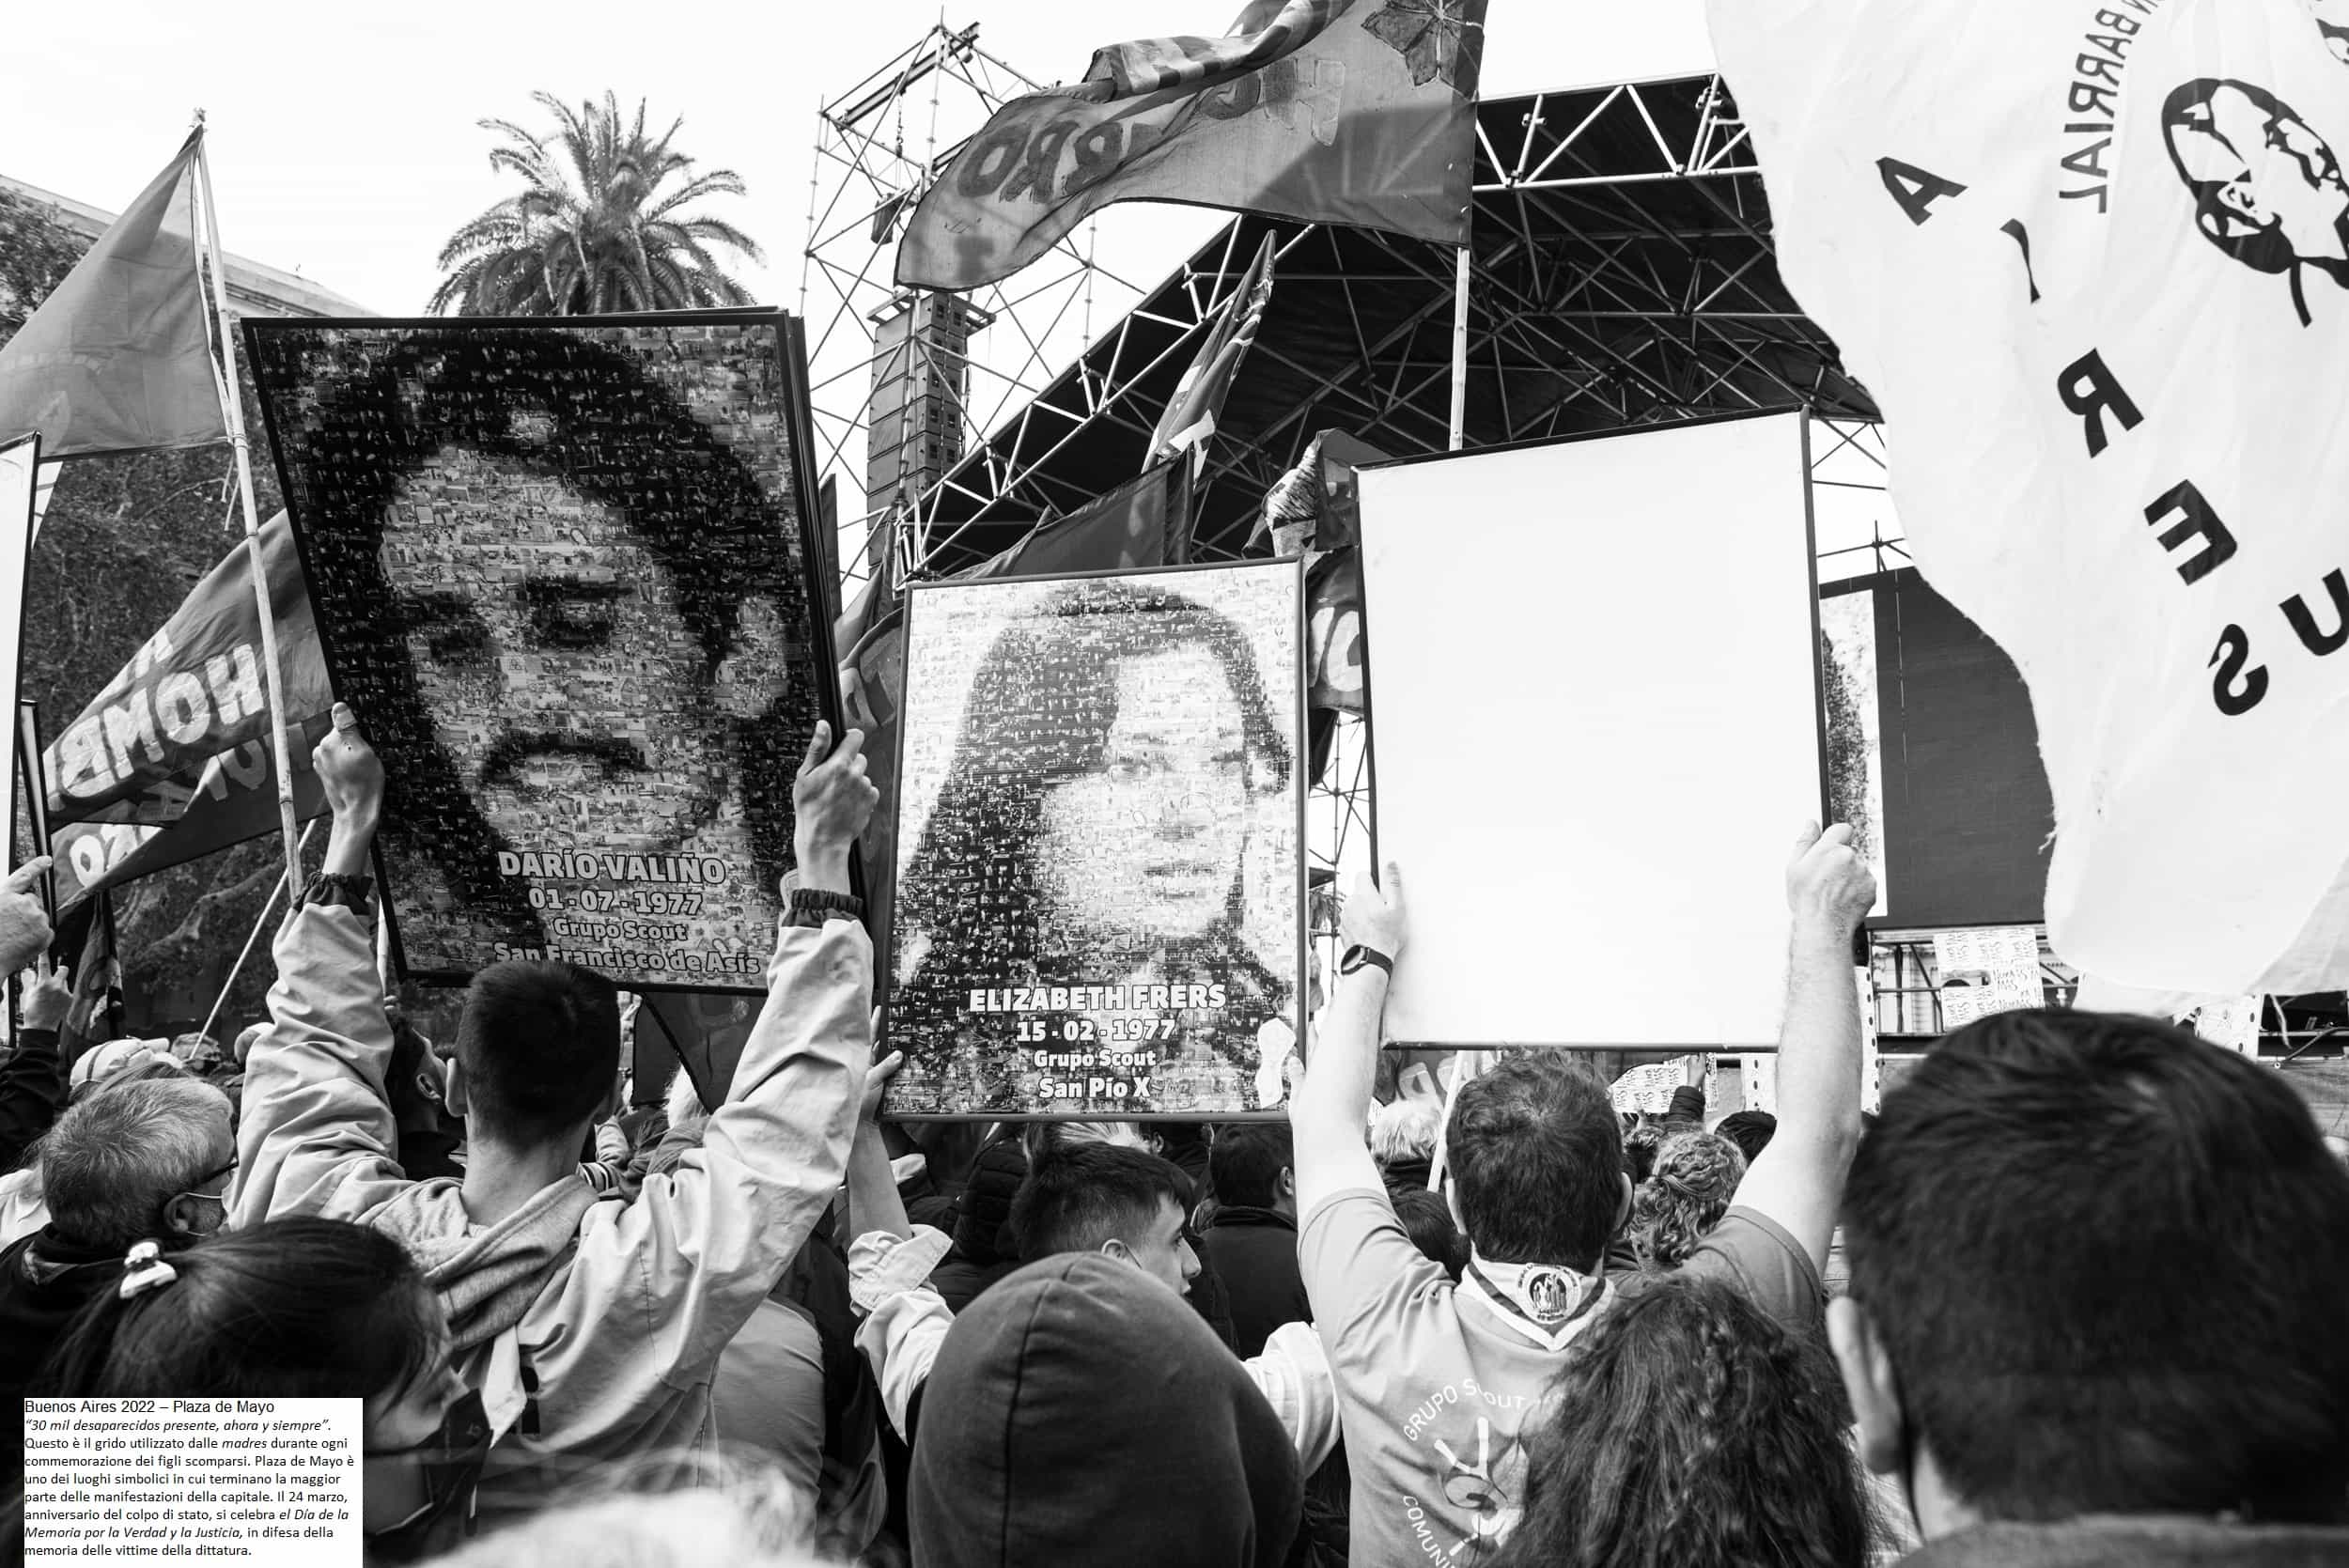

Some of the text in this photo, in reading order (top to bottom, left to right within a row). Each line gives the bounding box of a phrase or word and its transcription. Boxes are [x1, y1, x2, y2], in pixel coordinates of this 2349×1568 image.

[497, 848, 726, 885] DARÍO VALIÑO
[633, 891, 703, 916] 1977
[553, 917, 688, 942] Grupo Scout
[493, 941, 541, 962] San
[545, 943, 666, 970] Francisco
[669, 949, 702, 971] de
[969, 983, 1227, 1012] ELIZABETH FRERS
[1112, 1018, 1176, 1042] 1977
[1034, 1048, 1157, 1071] Grupo Scout
[1038, 1077, 1083, 1098] San
[1132, 1076, 1151, 1097] X
[1404, 1384, 1458, 1441] GRUPO
[1403, 1495, 1456, 1568] COMUNI
